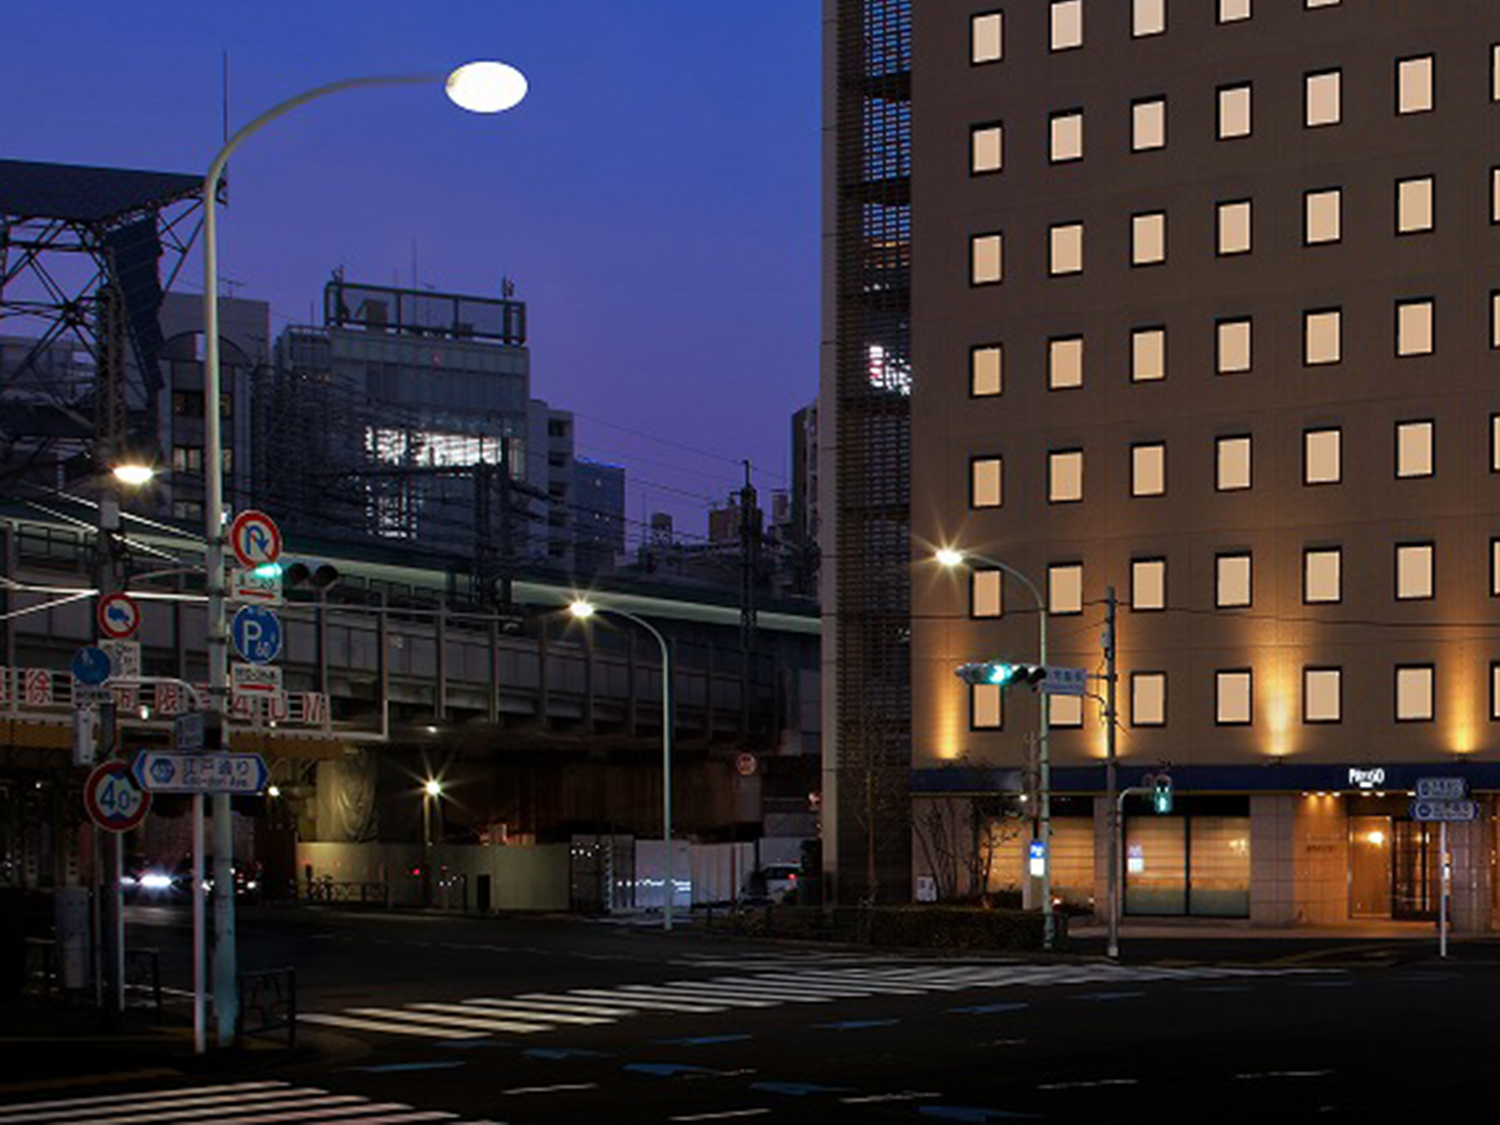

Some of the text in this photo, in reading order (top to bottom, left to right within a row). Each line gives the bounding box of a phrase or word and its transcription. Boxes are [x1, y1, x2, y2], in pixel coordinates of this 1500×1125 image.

[243, 620, 263, 656] P
[183, 757, 250, 777] 江戸通り
